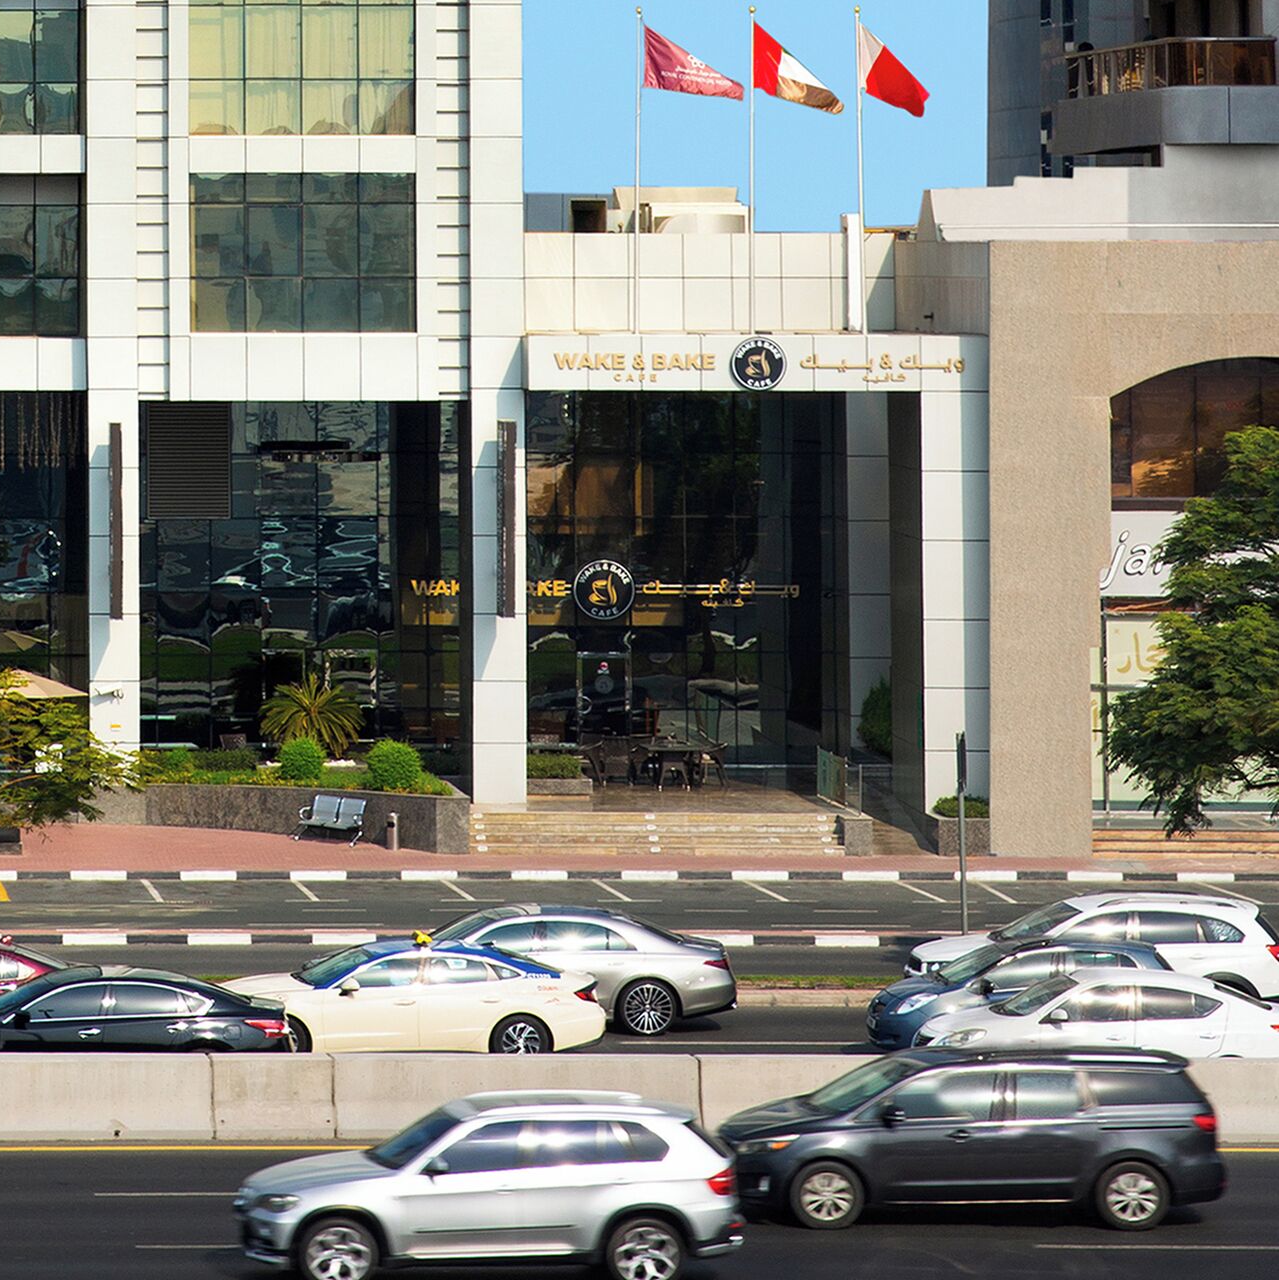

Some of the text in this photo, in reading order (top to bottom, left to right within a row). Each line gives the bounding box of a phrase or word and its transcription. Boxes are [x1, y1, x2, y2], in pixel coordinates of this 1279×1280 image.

[555, 351, 716, 371] WAKE & BAKE
[879, 352, 894, 370] &
[613, 372, 658, 383] CAFE
[747, 378, 772, 388] CAFE
[579, 563, 602, 584] WAKE
[609, 564, 631, 585] BAKE
[410, 578, 567, 598] WAK AKE
[590, 607, 619, 617] CAFE
